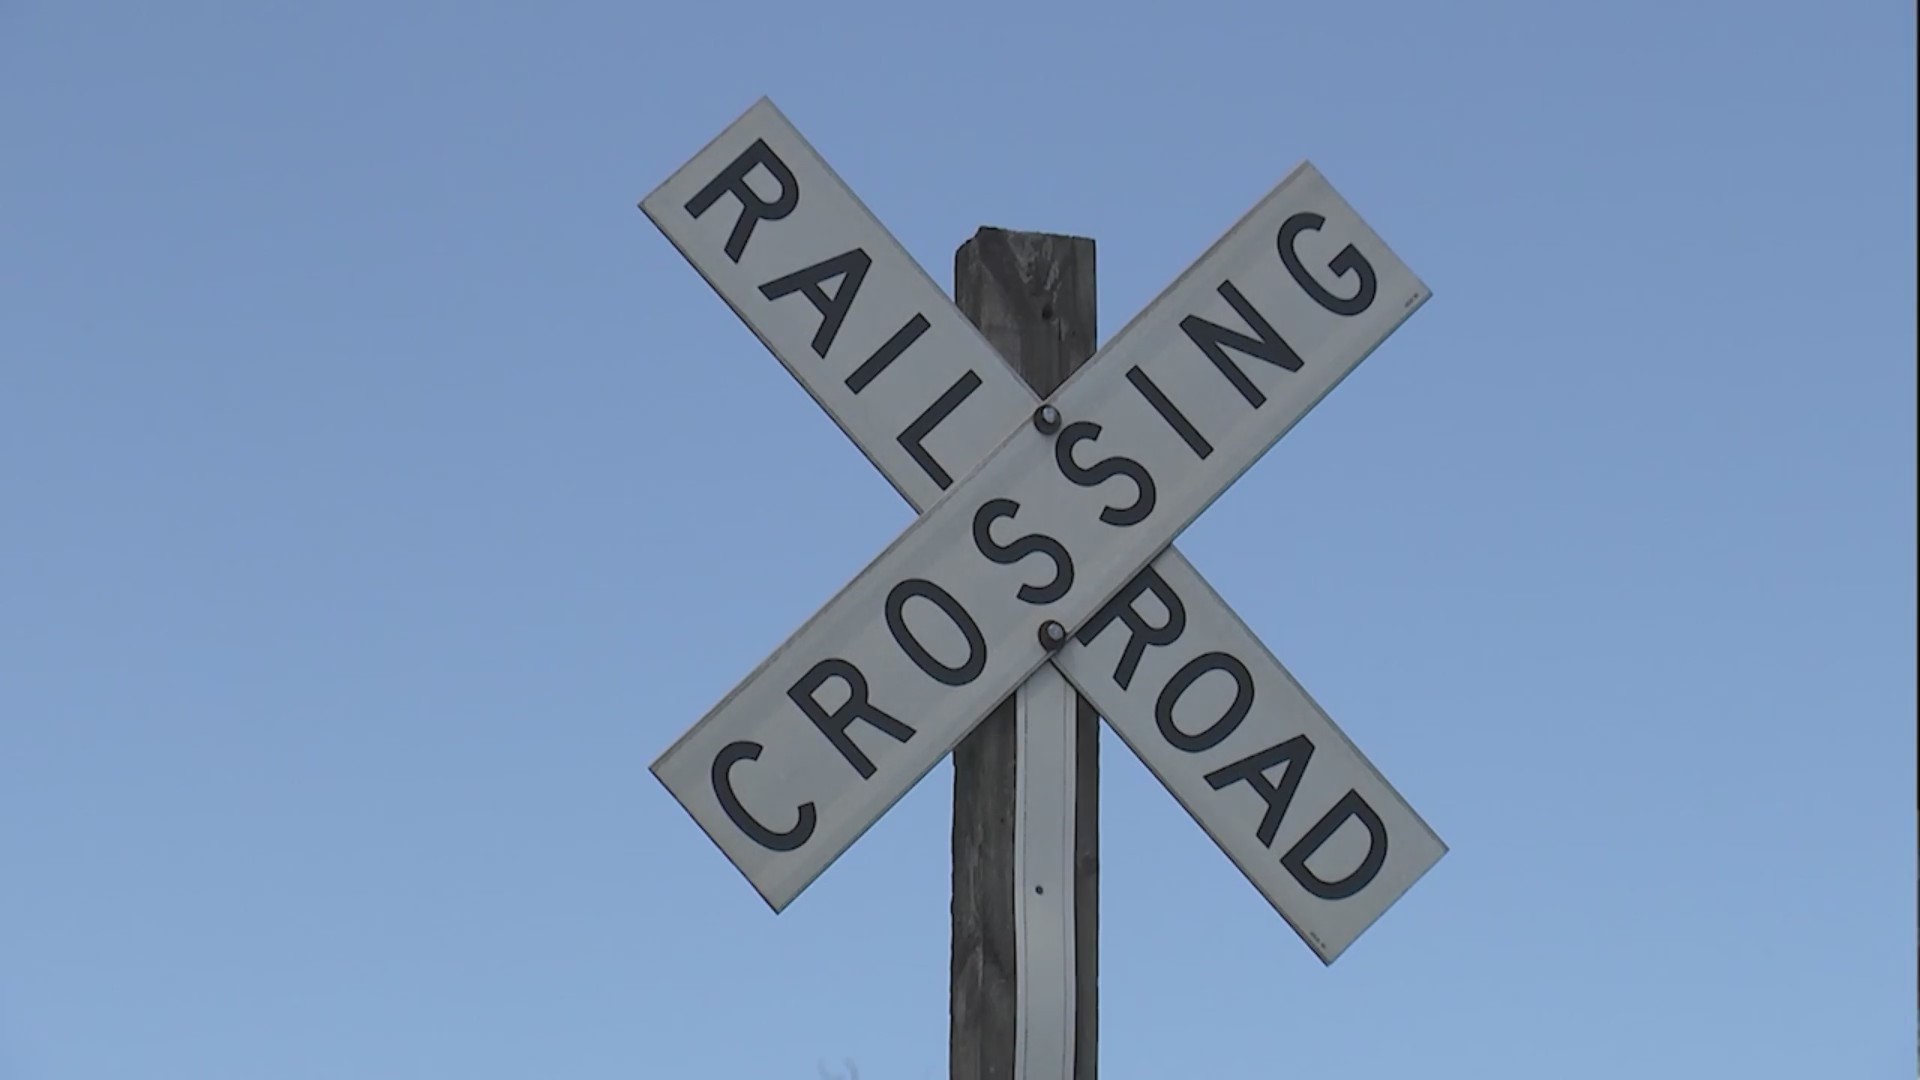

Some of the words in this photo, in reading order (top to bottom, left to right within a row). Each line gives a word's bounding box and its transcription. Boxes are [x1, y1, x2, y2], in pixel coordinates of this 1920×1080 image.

[684, 138, 983, 491] RAIL
[1075, 565, 1389, 901] ROAD
[711, 212, 1378, 852] CROSSING
